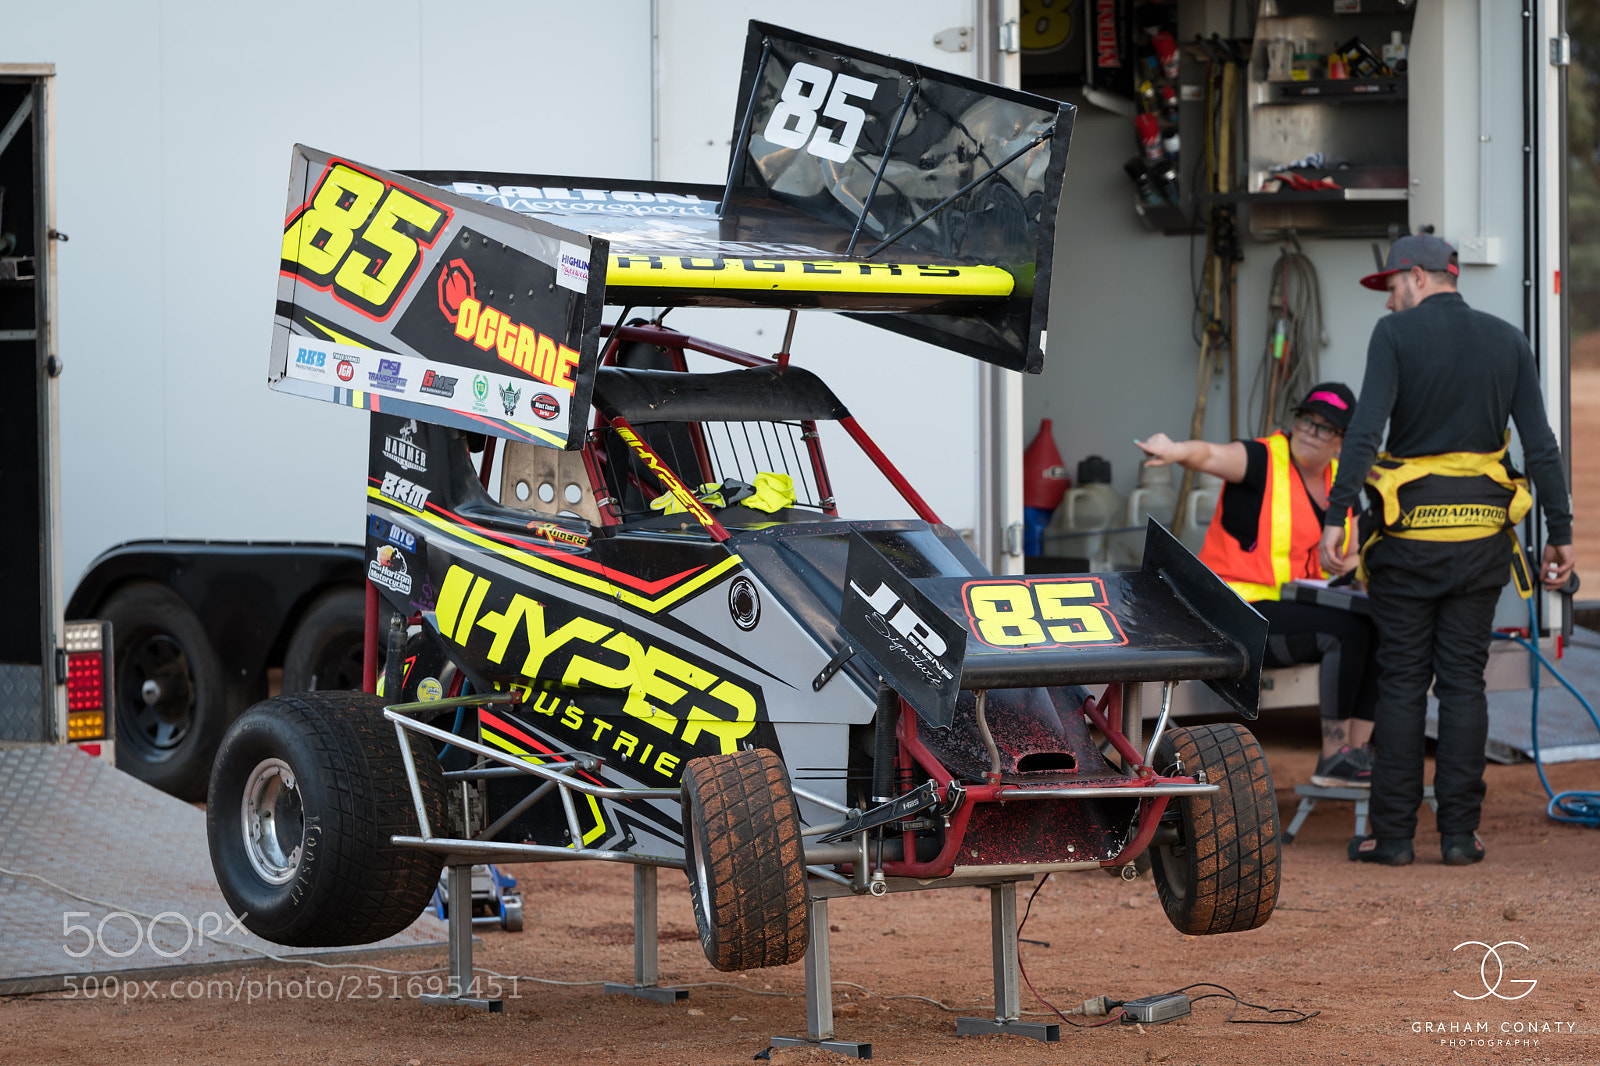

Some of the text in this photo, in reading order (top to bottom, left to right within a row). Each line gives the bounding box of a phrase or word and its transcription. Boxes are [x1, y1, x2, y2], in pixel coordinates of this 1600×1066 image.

[764, 62, 878, 164] 85
[452, 182, 702, 204] DALTON
[281, 164, 442, 306] 85
[561, 254, 590, 270] HIGHLIN
[296, 347, 327, 368] RKB
[339, 364, 352, 378] IGA
[385, 436, 427, 467] HAMMER
[380, 471, 432, 509] BRM
[1416, 507, 1506, 520] BROADWOOD
[536, 523, 588, 546] ROGERS
[370, 568, 410, 592] Motorcycles
[381, 563, 410, 585] Horizon
[970, 582, 1114, 646] 85
[435, 564, 757, 755] HYPER
[907, 635, 954, 680] SIGNS
